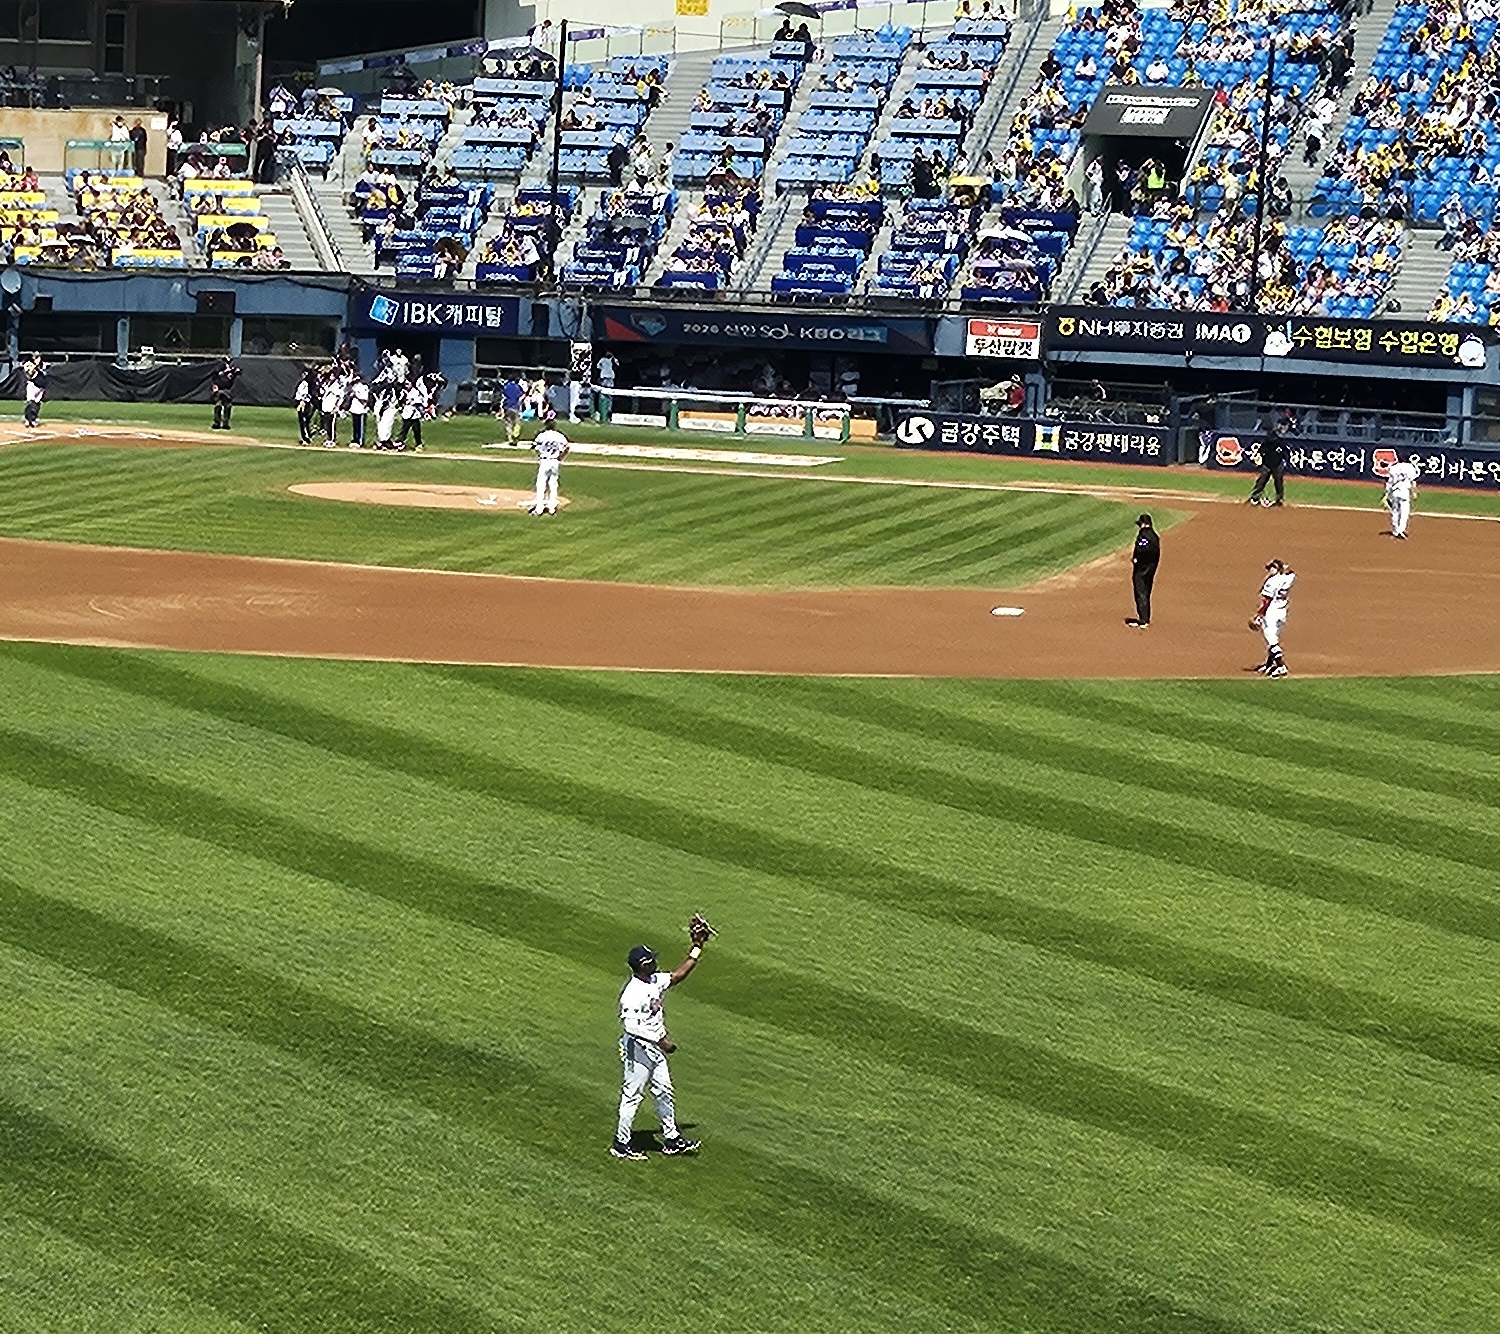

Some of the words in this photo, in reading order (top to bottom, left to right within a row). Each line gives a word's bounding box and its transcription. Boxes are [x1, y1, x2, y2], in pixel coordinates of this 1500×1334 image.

[403, 301, 504, 327] IBK캐피탈
[1078, 318, 1184, 339] NH투자증권
[1293, 325, 1372, 351] 수협보험
[1379, 330, 1459, 356] 수협은행
[941, 422, 1020, 448] 금강주택
[1064, 430, 1161, 456] 금강펜테리움
